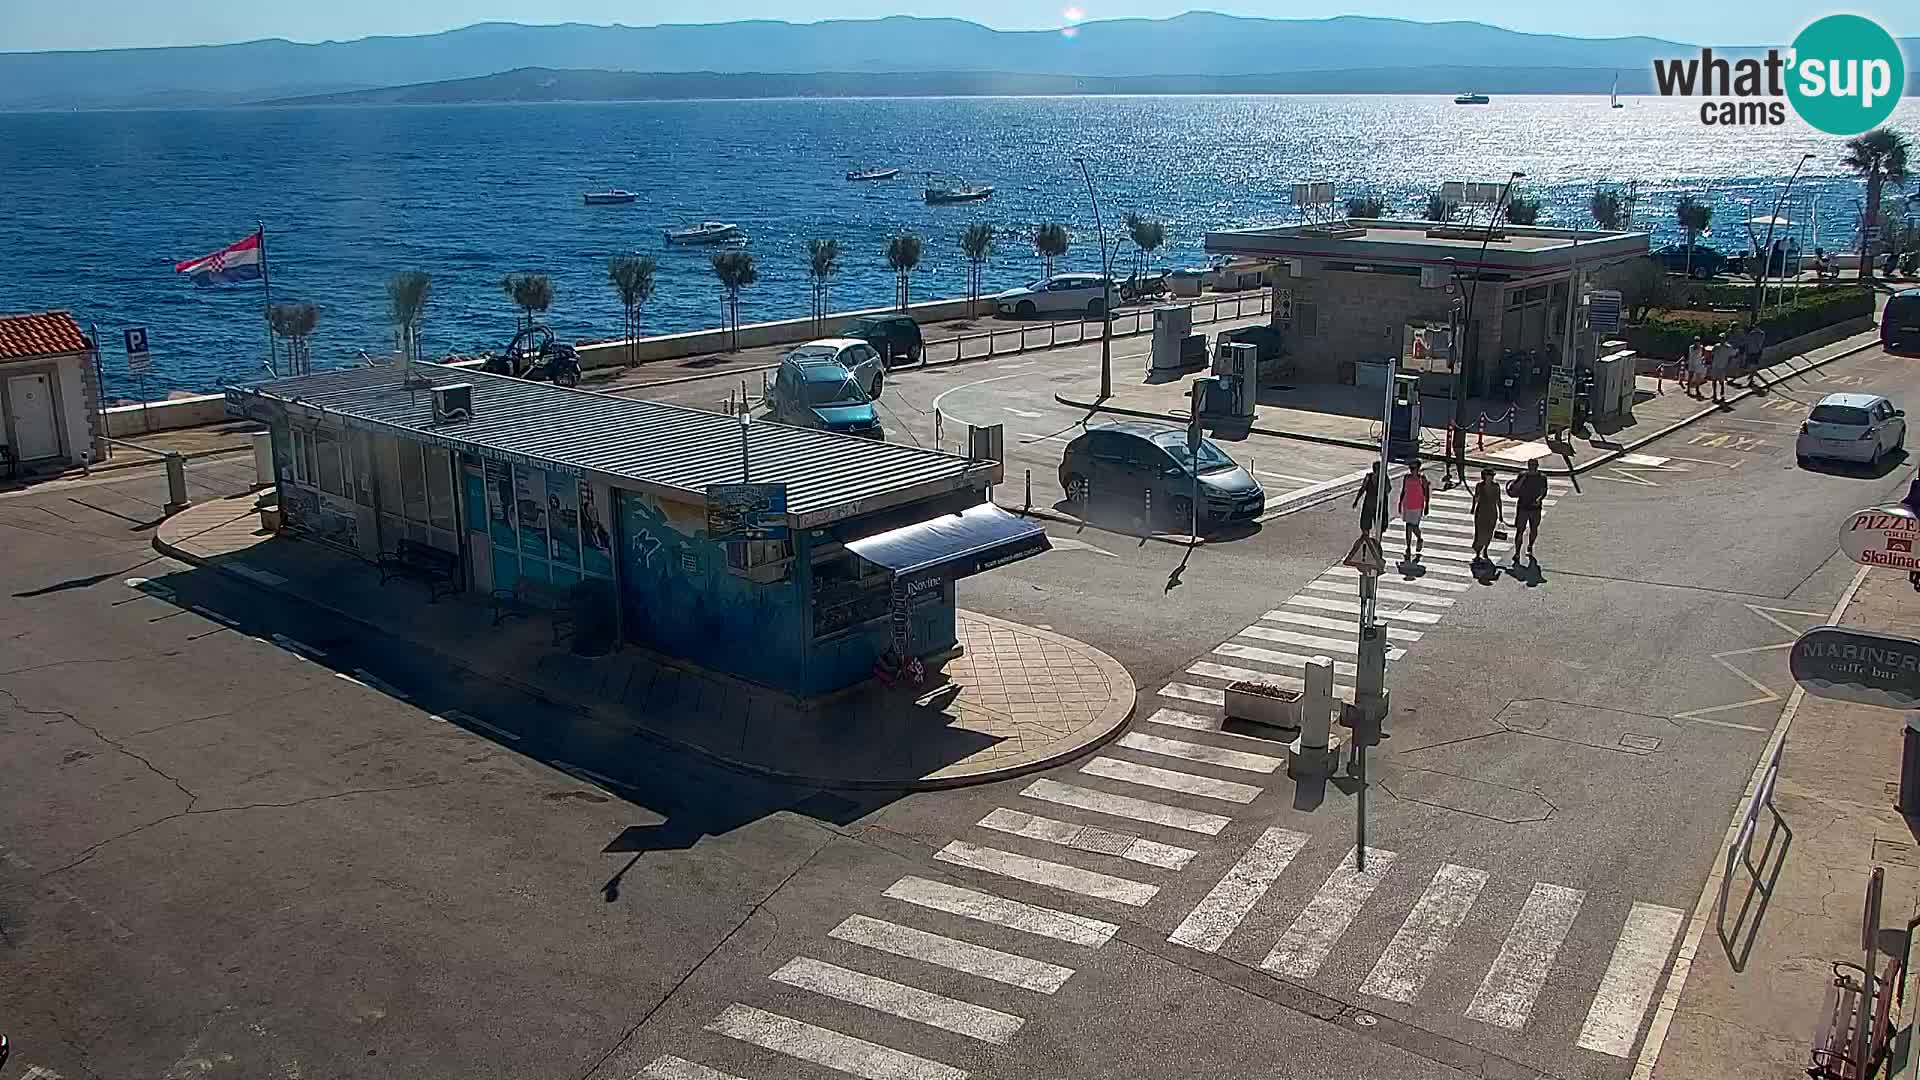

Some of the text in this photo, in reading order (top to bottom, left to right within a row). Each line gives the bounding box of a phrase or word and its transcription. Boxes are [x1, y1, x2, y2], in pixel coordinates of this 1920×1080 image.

[129, 331, 142, 350] P
[1687, 430, 1766, 452] TAXI
[1849, 515, 1920, 533] PIZZE
[1800, 640, 1920, 672] MARINER
